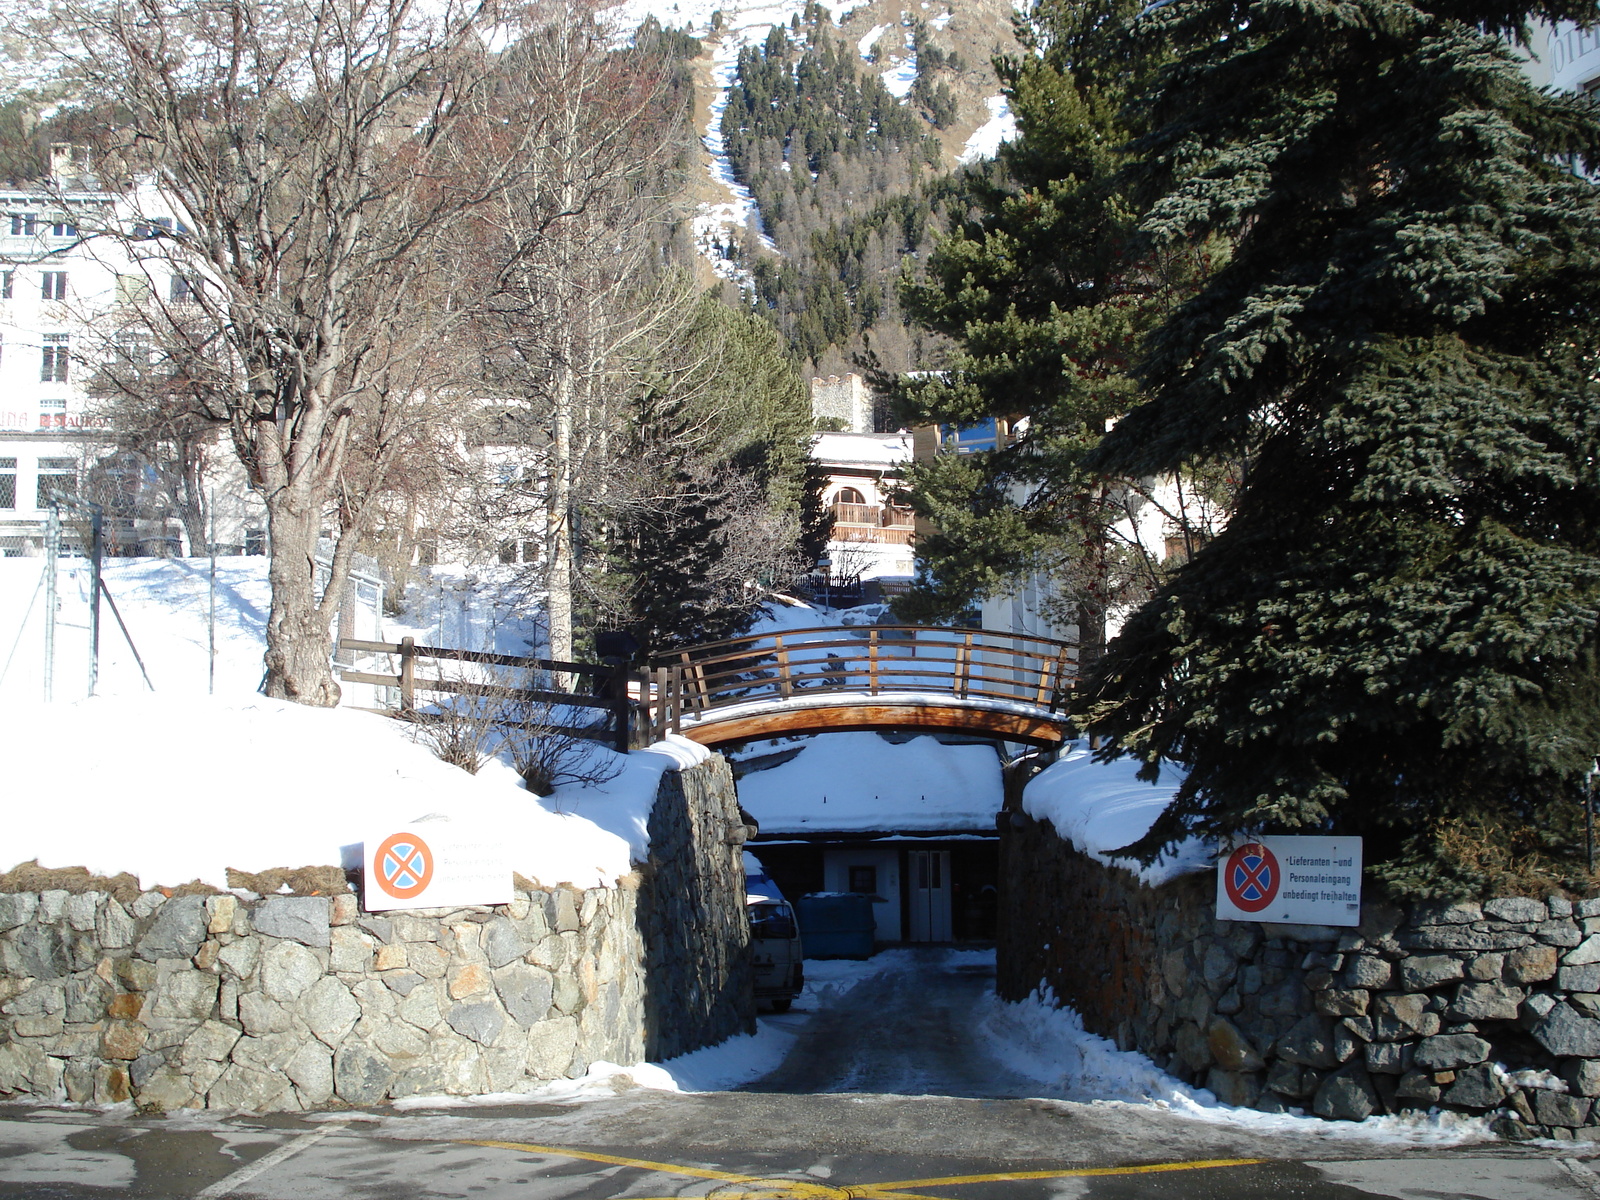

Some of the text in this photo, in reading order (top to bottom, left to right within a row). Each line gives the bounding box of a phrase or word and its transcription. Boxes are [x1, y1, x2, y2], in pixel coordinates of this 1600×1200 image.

[40, 415, 113, 428] RESTAURAN
[1289, 856, 1331, 867] Lieferanten
[1289, 873, 1351, 886] Personaleingang
[1282, 890, 1357, 903] unbedingt freihalten
